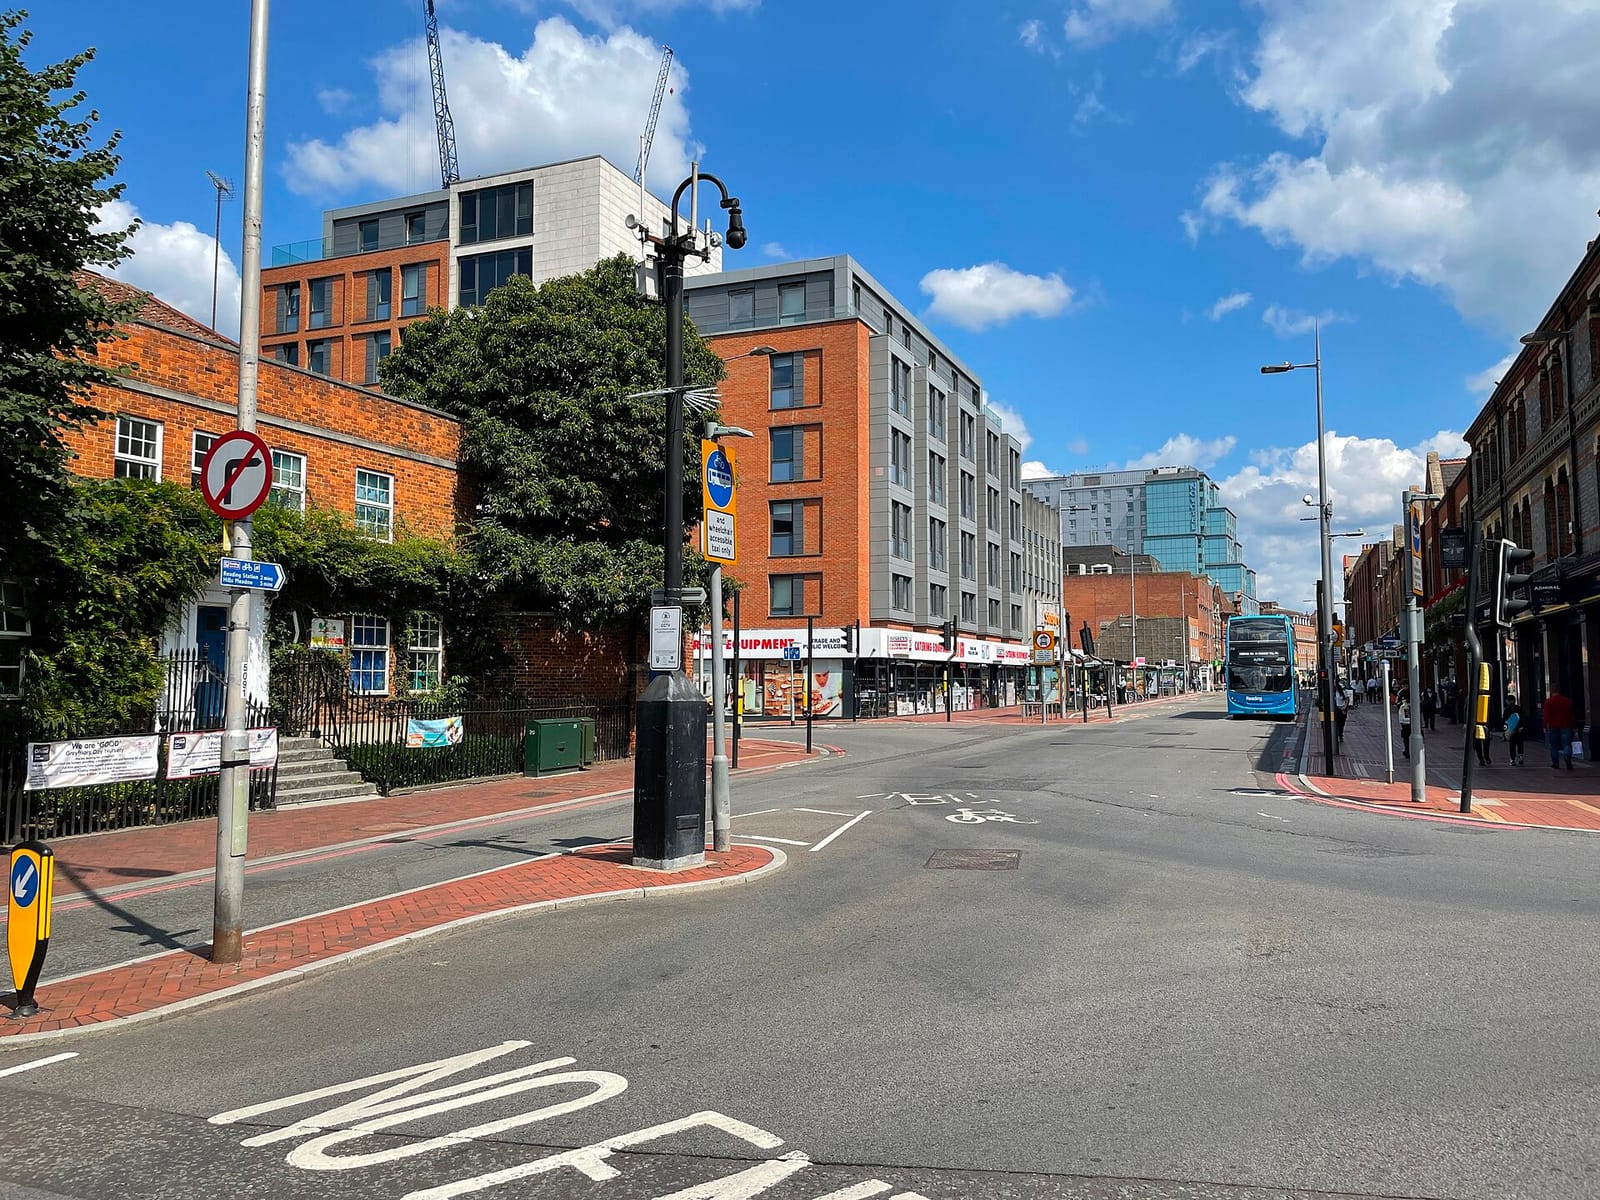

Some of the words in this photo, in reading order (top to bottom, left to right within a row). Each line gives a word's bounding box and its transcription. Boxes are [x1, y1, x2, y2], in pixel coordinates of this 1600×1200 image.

[709, 524, 733, 536] wheelchair
[710, 535, 733, 546] accessible
[711, 544, 721, 553] taxi
[721, 547, 731, 556] only
[223, 571, 241, 579] Reading
[242, 572, 259, 580] Station
[726, 638, 795, 650] EUIPMENT
[71, 742, 83, 750] We
[207, 1040, 629, 1170] NO
